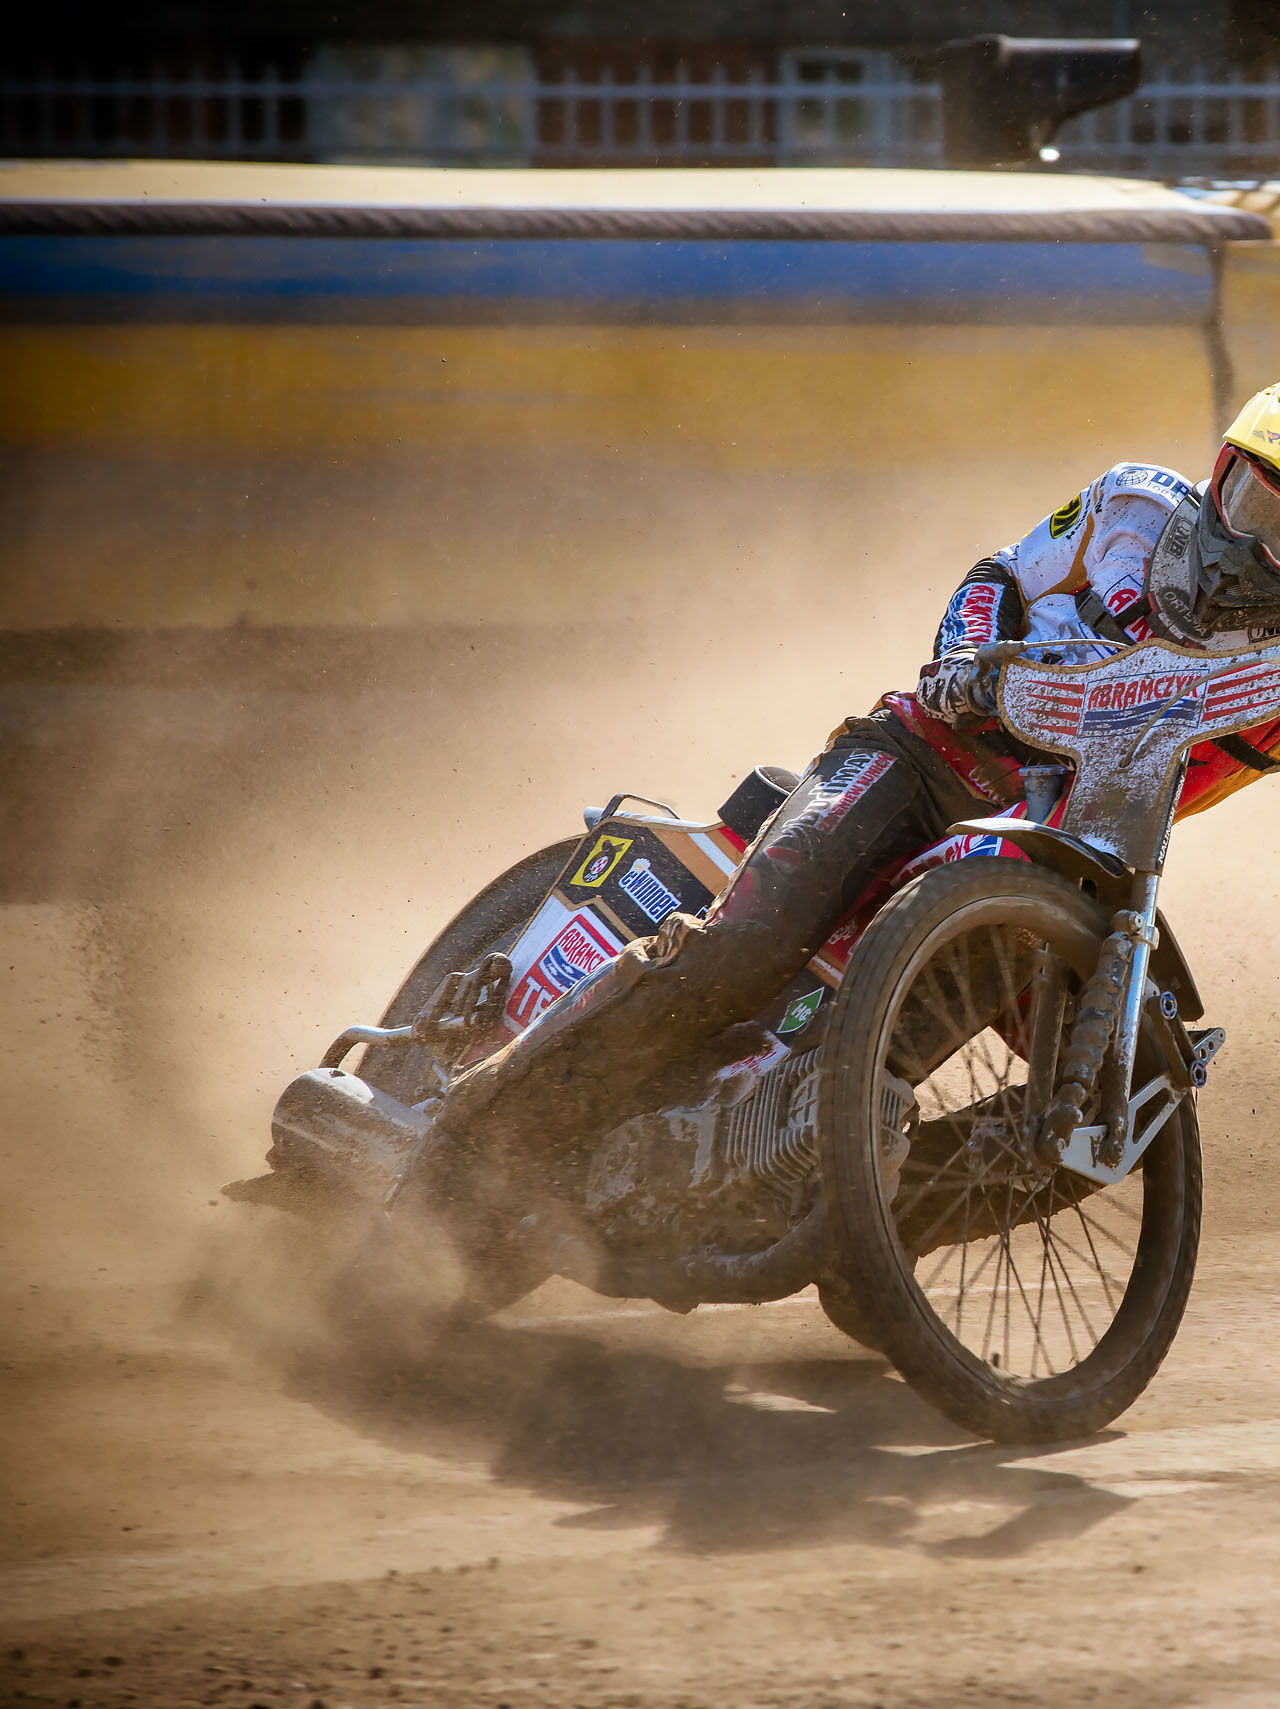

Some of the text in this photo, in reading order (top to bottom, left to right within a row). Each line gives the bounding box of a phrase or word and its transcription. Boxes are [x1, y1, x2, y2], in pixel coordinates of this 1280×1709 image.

[1163, 591, 1208, 637] ORTEMA
[1087, 675, 1201, 711] ABRAMCZYK
[558, 928, 605, 973] ABRAMC
